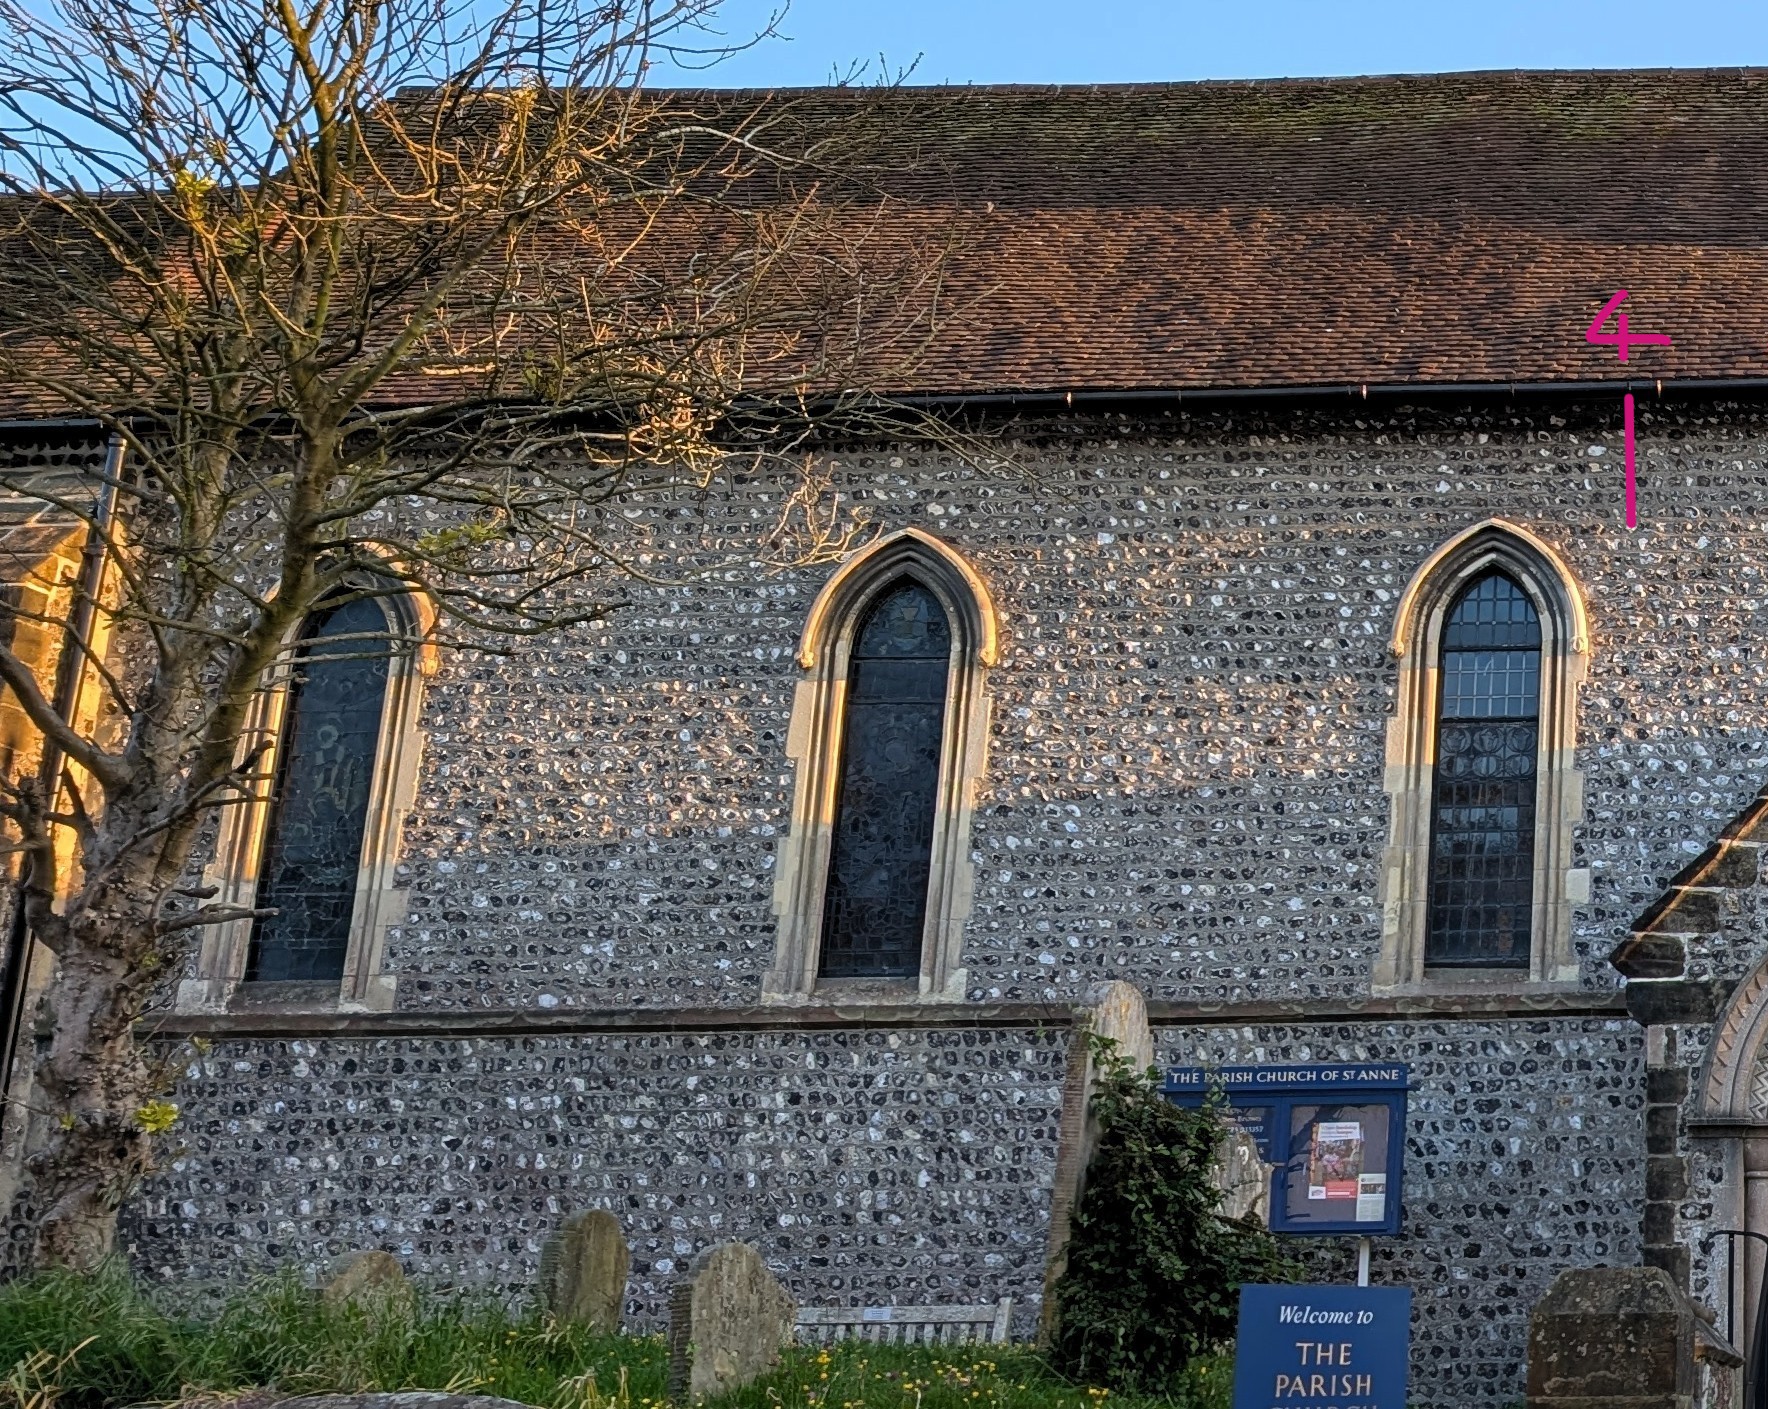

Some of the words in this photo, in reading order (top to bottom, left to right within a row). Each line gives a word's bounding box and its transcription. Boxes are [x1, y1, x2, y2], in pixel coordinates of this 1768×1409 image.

[1172, 1072, 1199, 1084] THE
[1204, 1071, 1253, 1083] PARISH
[1256, 1070, 1316, 1082] CHURCH
[1321, 1070, 1339, 1081] OF
[1357, 1069, 1399, 1081] ANNE
[1279, 1305, 1353, 1324] Welcome
[1357, 1310, 1374, 1324] to
[1295, 1342, 1353, 1366] THE
[1275, 1374, 1371, 1398] PARISH
